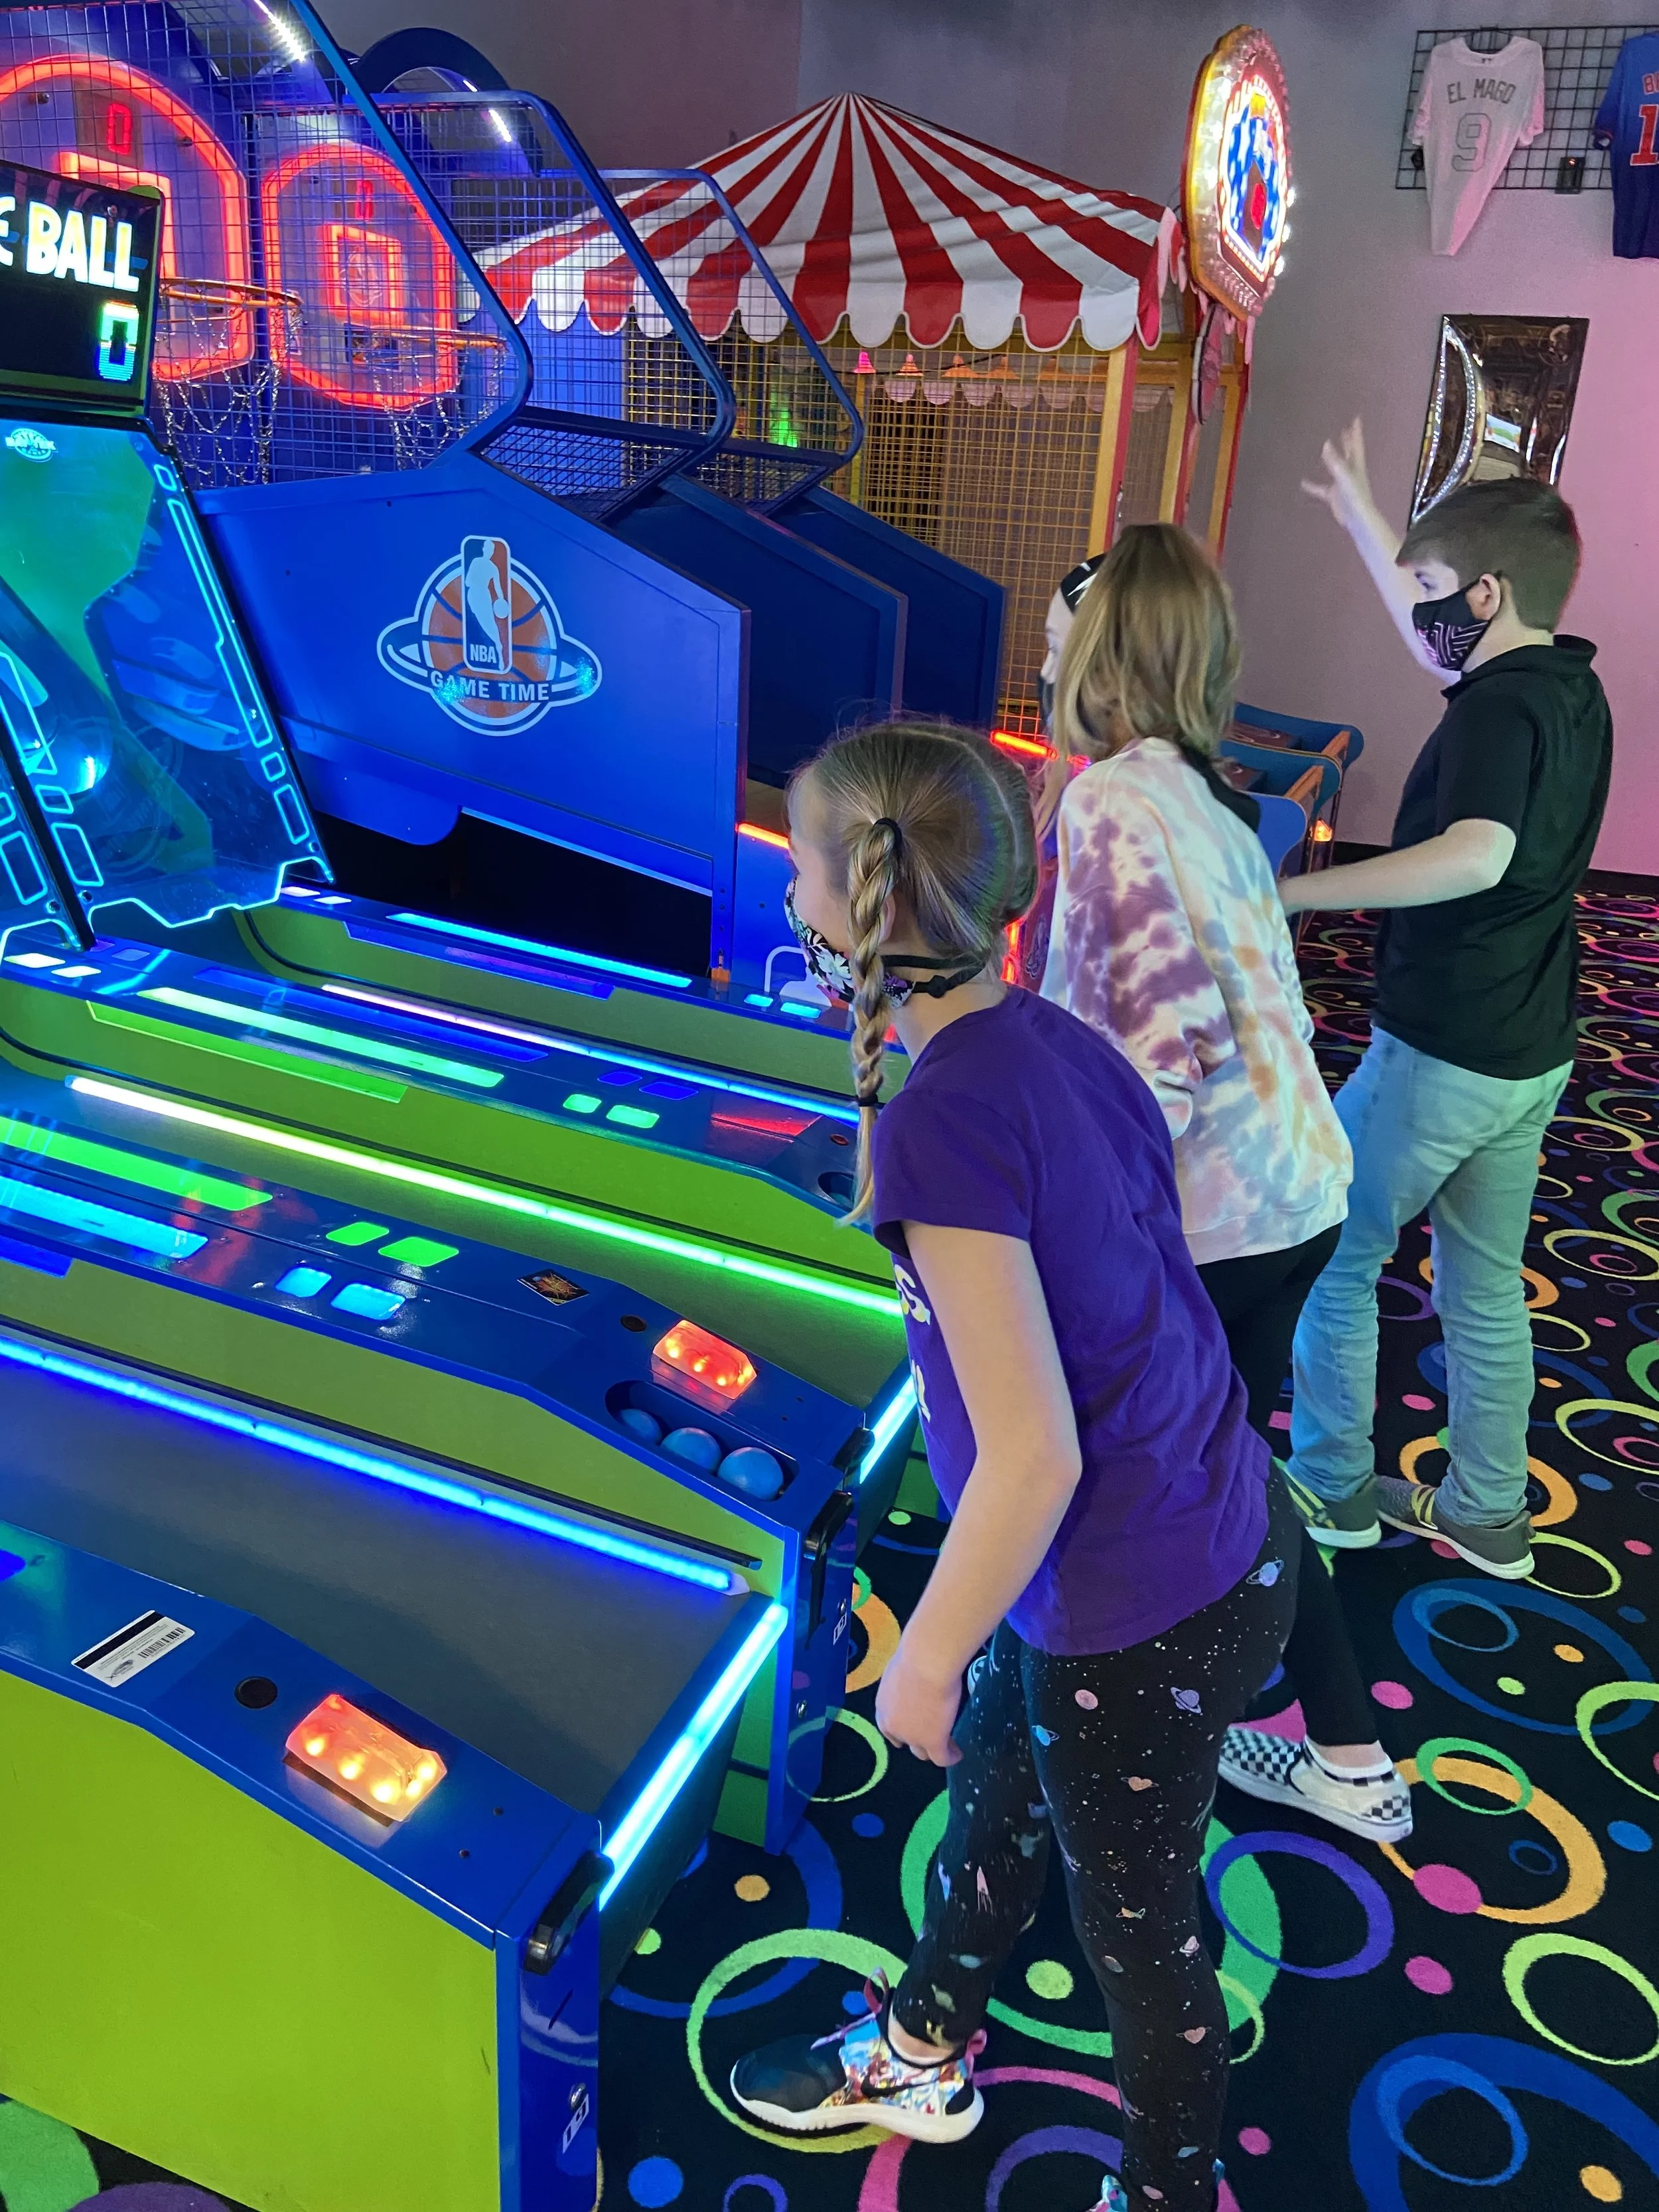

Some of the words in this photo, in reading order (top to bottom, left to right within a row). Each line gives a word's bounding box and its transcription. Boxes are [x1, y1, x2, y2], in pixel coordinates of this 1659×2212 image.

[1447, 82, 1466, 104] EL
[1473, 79, 1516, 104] MAGO
[1452, 113, 1491, 172] 9
[26, 201, 139, 292] BALL
[99, 302, 139, 381] 0
[470, 644, 496, 663] NBA
[431, 670, 490, 698] GAME
[499, 682, 549, 701] TIME
